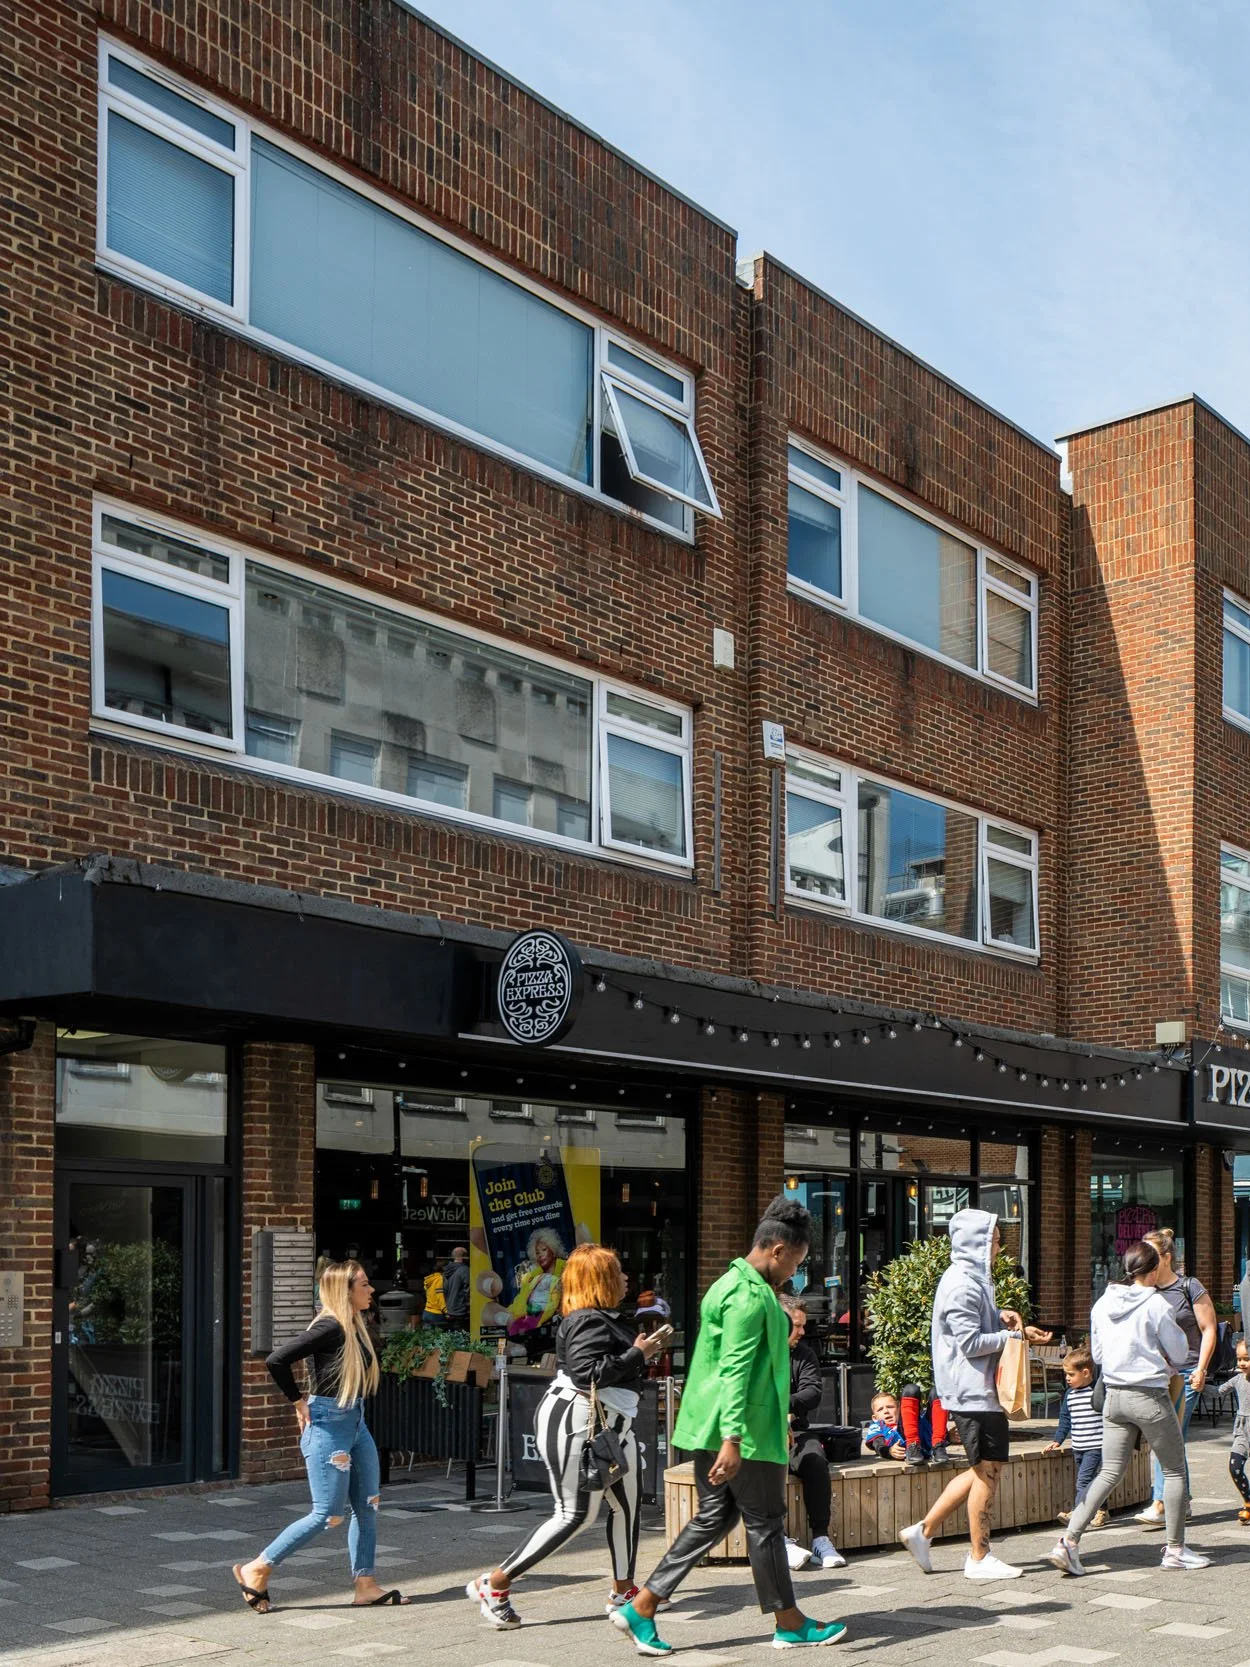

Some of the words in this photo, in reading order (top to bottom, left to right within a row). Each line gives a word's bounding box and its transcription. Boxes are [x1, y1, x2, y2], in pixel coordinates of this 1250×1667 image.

[516, 970, 554, 986] PIZZA
[506, 982, 564, 1001] EXPRESS
[485, 1178, 517, 1195] Join
[488, 1198, 512, 1212] the
[514, 1189, 545, 1206] Club
[491, 1213, 505, 1224] and
[506, 1212, 518, 1223] get
[518, 1208, 533, 1218] free
[534, 1200, 563, 1214] rewards
[493, 1223, 514, 1234] every
[514, 1219, 530, 1229] time
[531, 1216, 544, 1226] you
[545, 1211, 560, 1221] dine
